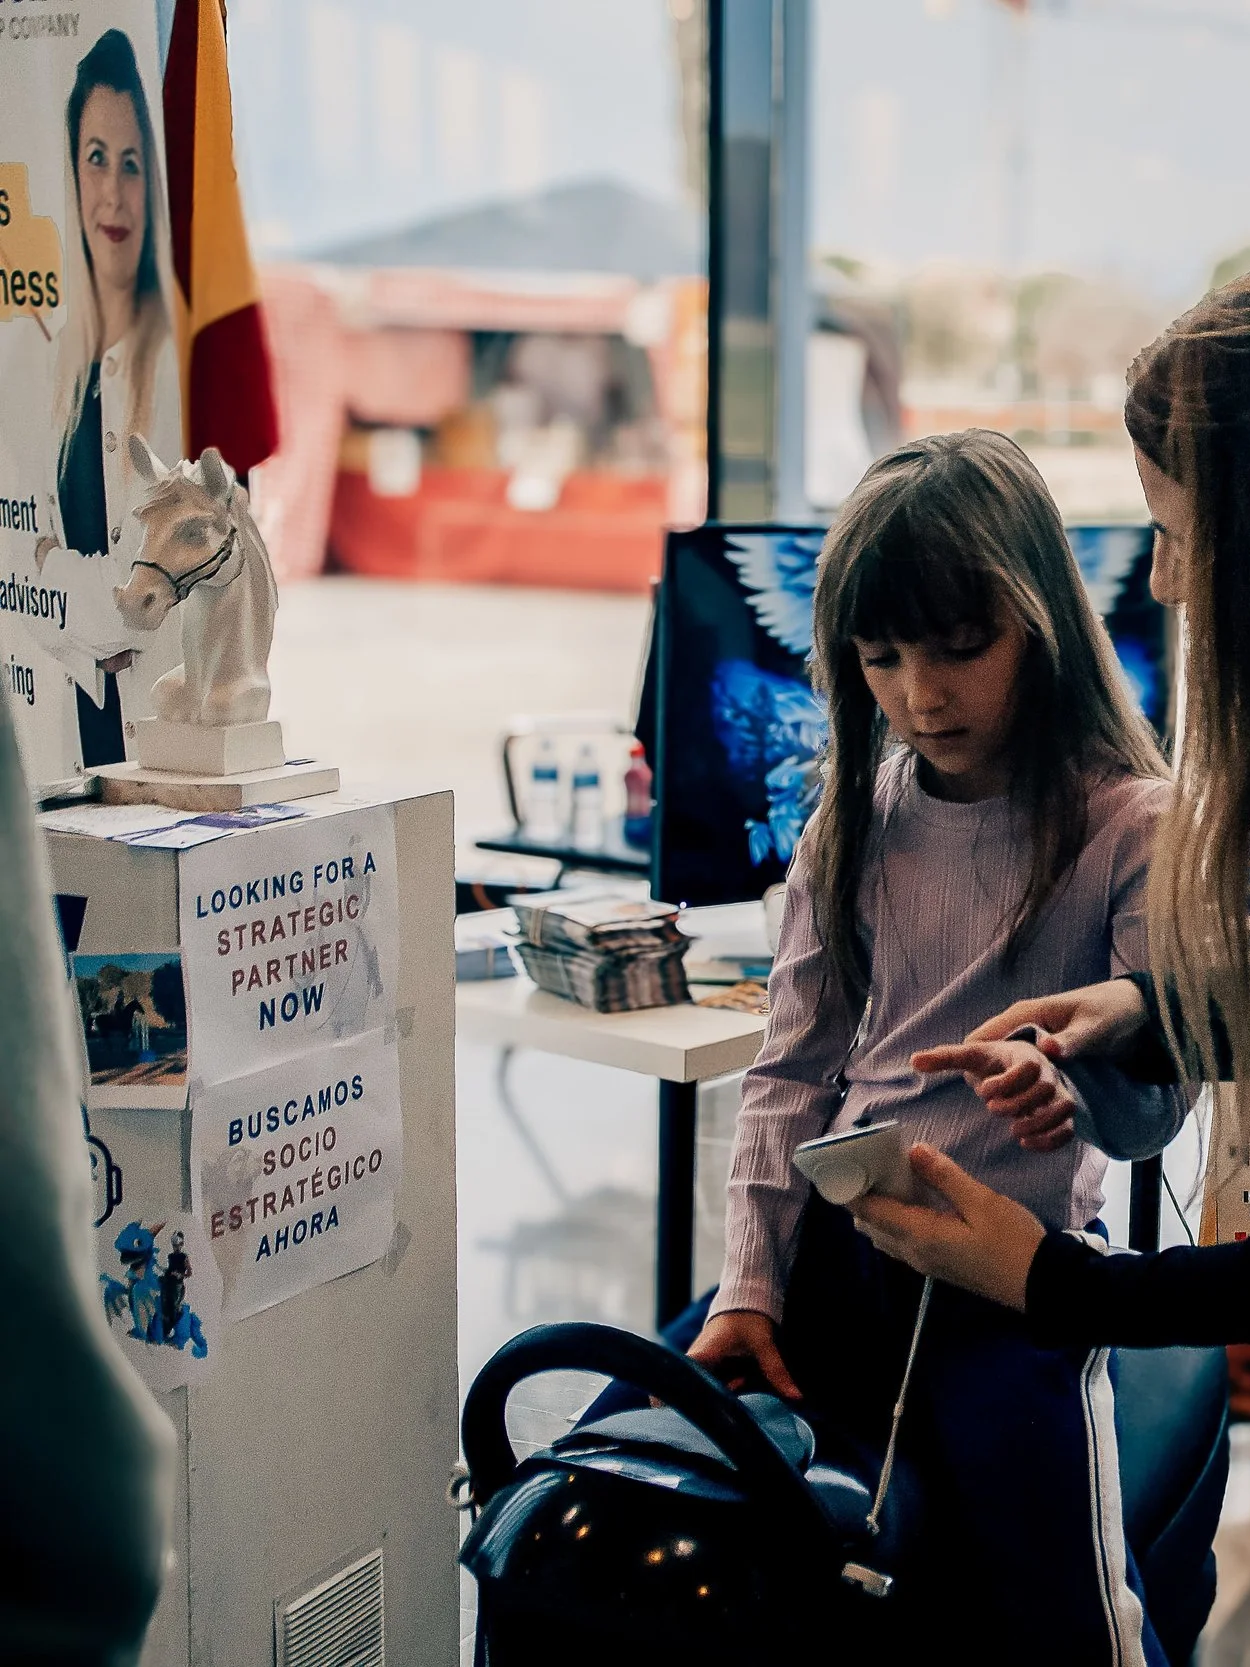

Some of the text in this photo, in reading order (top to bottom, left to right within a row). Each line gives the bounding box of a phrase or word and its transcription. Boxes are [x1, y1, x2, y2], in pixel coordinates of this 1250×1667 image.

[0, 572, 67, 630] advisory
[4, 654, 35, 705] ing
[196, 852, 376, 919] LOOKING FOR A
[217, 894, 359, 956] STRATEGIC
[232, 939, 348, 997] PARTNER
[259, 982, 324, 1031] NOW
[228, 1074, 364, 1146] BUSCAMOS
[262, 1126, 337, 1176] SOCIO
[211, 1149, 383, 1239] ESTRATÉGICO
[255, 1205, 339, 1262] AHORA
